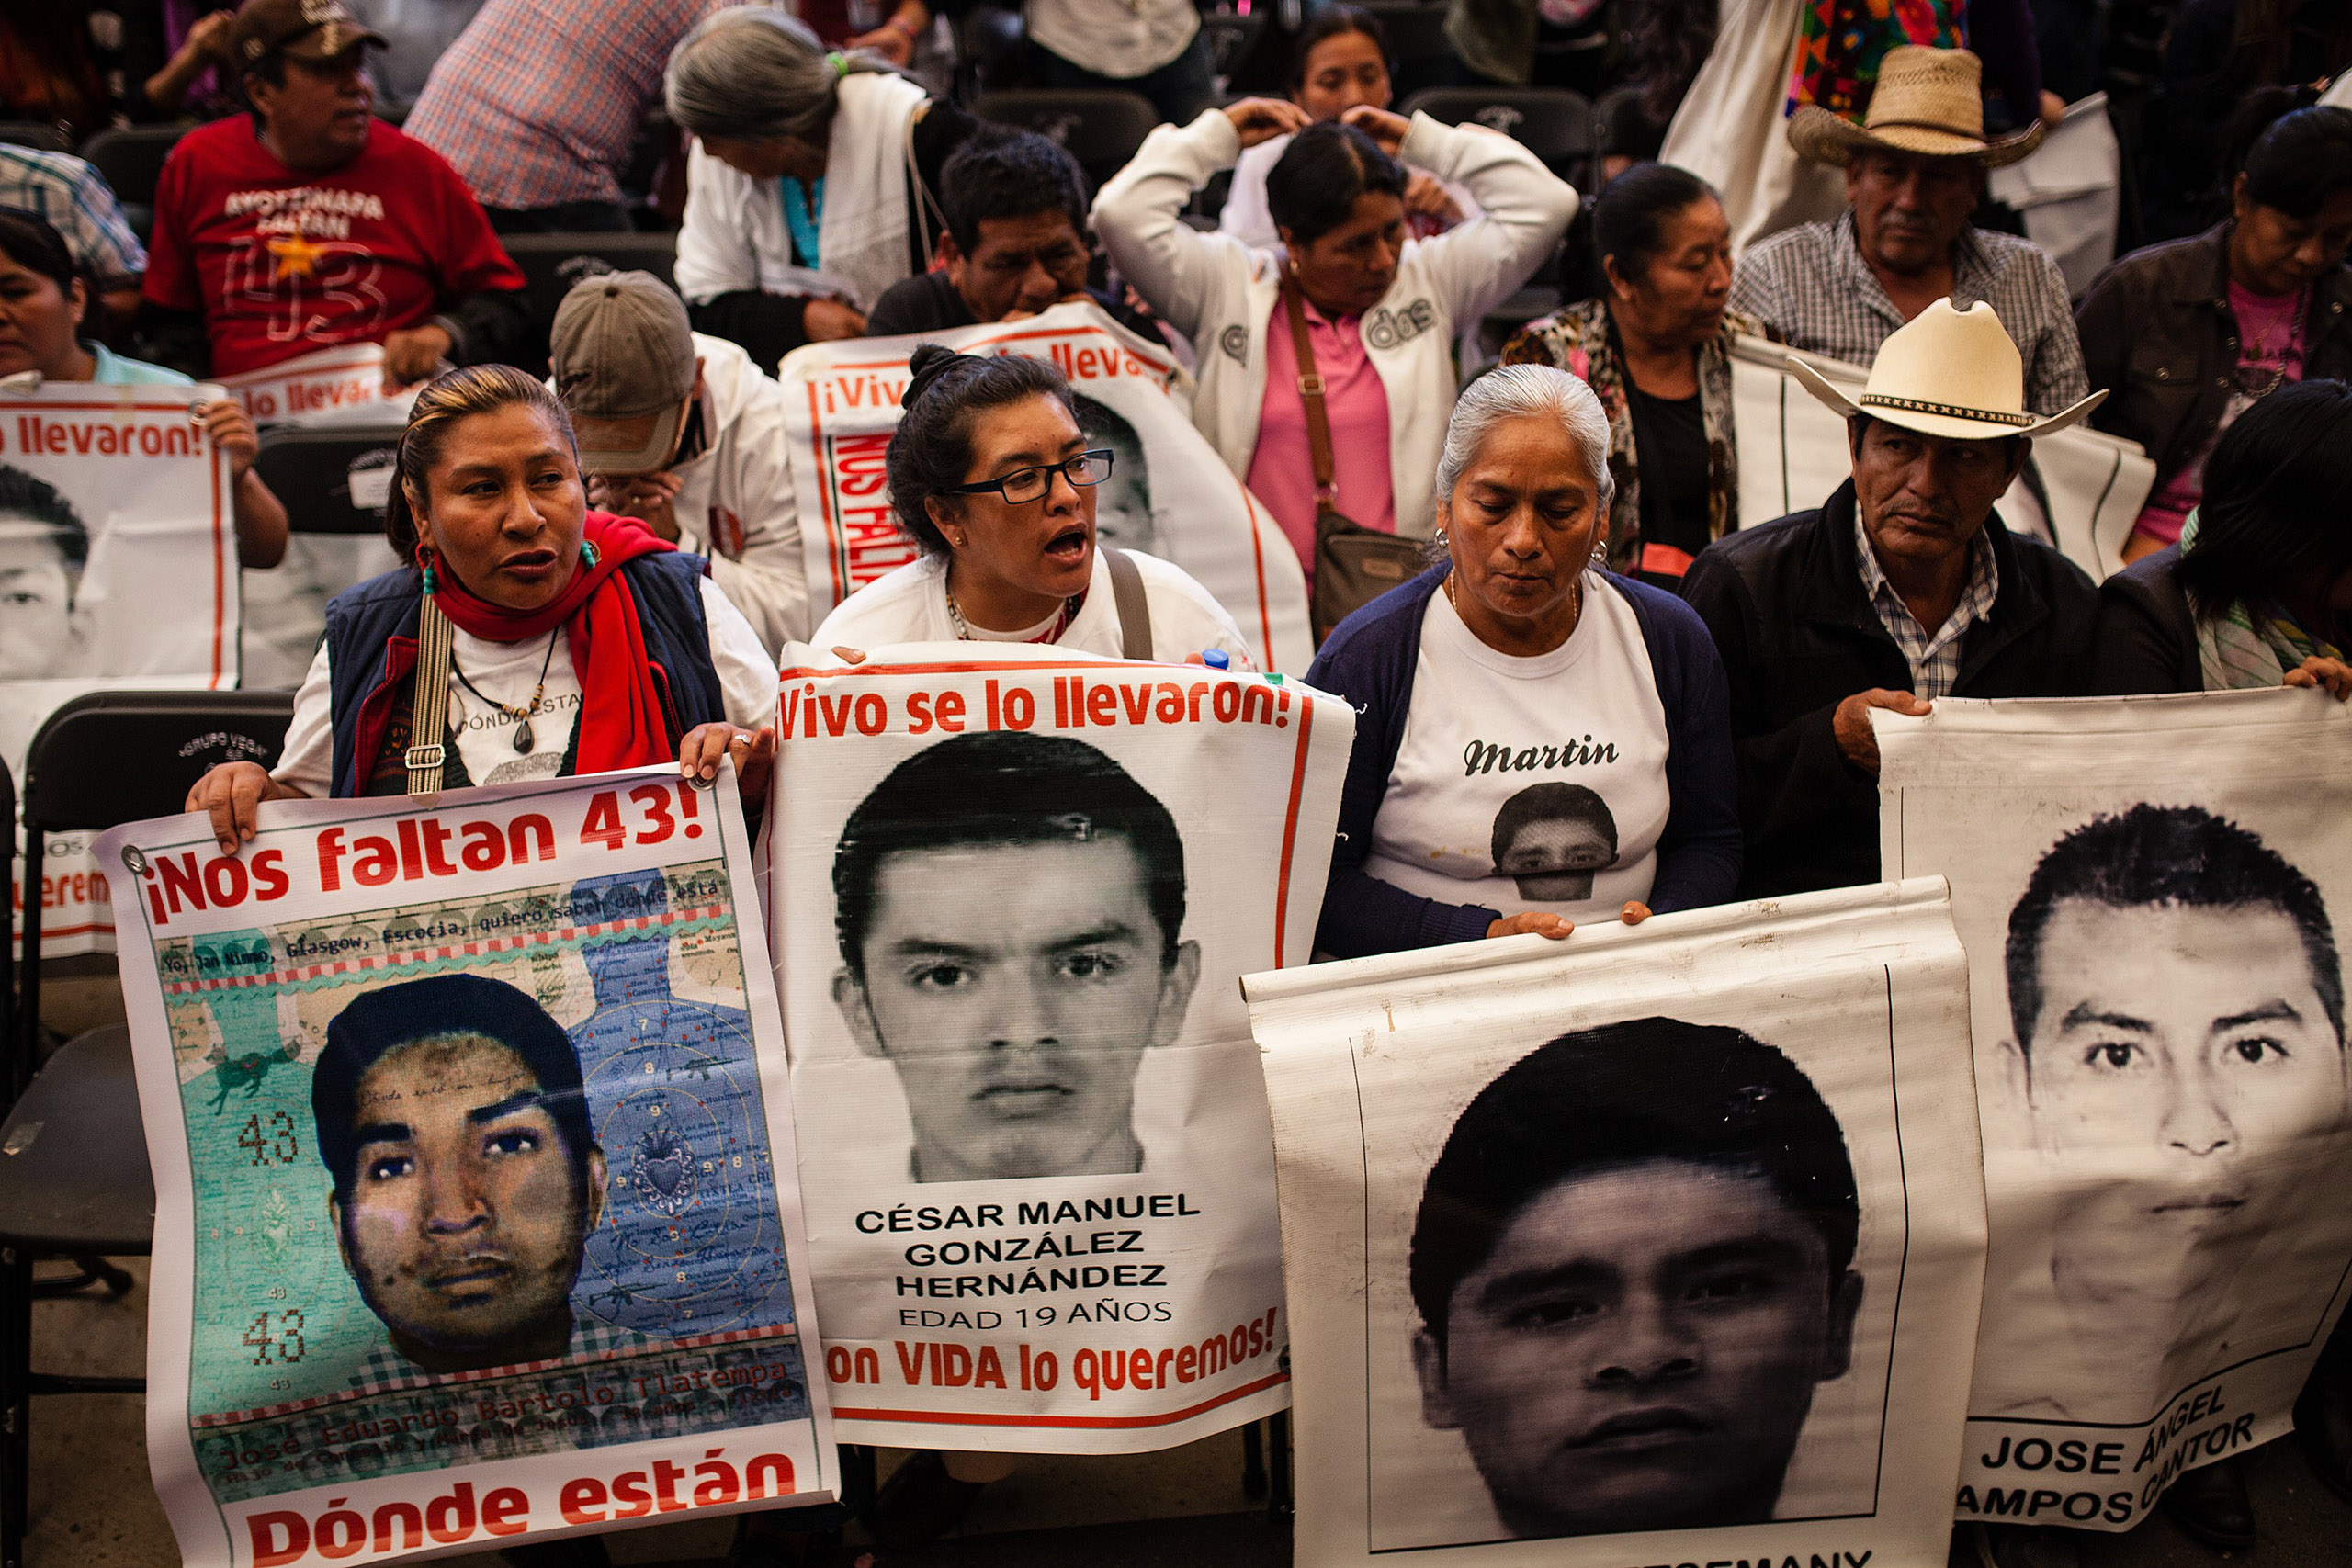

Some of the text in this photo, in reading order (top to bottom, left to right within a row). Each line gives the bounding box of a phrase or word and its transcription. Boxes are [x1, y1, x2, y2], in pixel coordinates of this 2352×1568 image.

[824, 374, 906, 413] ¡Viv
[17, 416, 202, 457] llevaron!
[907, 691, 966, 734] se
[985, 679, 1035, 732] lo
[1054, 675, 1290, 729] llevaron!
[1464, 734, 1620, 777] Martin
[143, 780, 704, 925] ¡Nos faltan 43!
[286, 936, 370, 958] Glasgow,
[382, 920, 467, 944] Escocia,
[480, 908, 542, 931] quiero
[237, 1111, 299, 1168] 43
[855, 1193, 1201, 1235] CÉSAR MANUEL
[905, 1230, 1145, 1267] GONZÁLEZ
[268, 1287, 287, 1300] 43
[895, 1264, 1168, 1298] HERNÁNDEZ
[243, 1307, 305, 1366] 43
[899, 1298, 1172, 1330] EDAD 19 AÑOS
[826, 1306, 1278, 1401] on VIDA lo queremos!
[218, 1361, 786, 1470] José Eduardo Bartolo Tlatempa
[1981, 1385, 2225, 1475] JOSE ÁNGEL
[1957, 1412, 2256, 1524] AMPOS CANTOR
[246, 1447, 797, 1568] Dónde están
